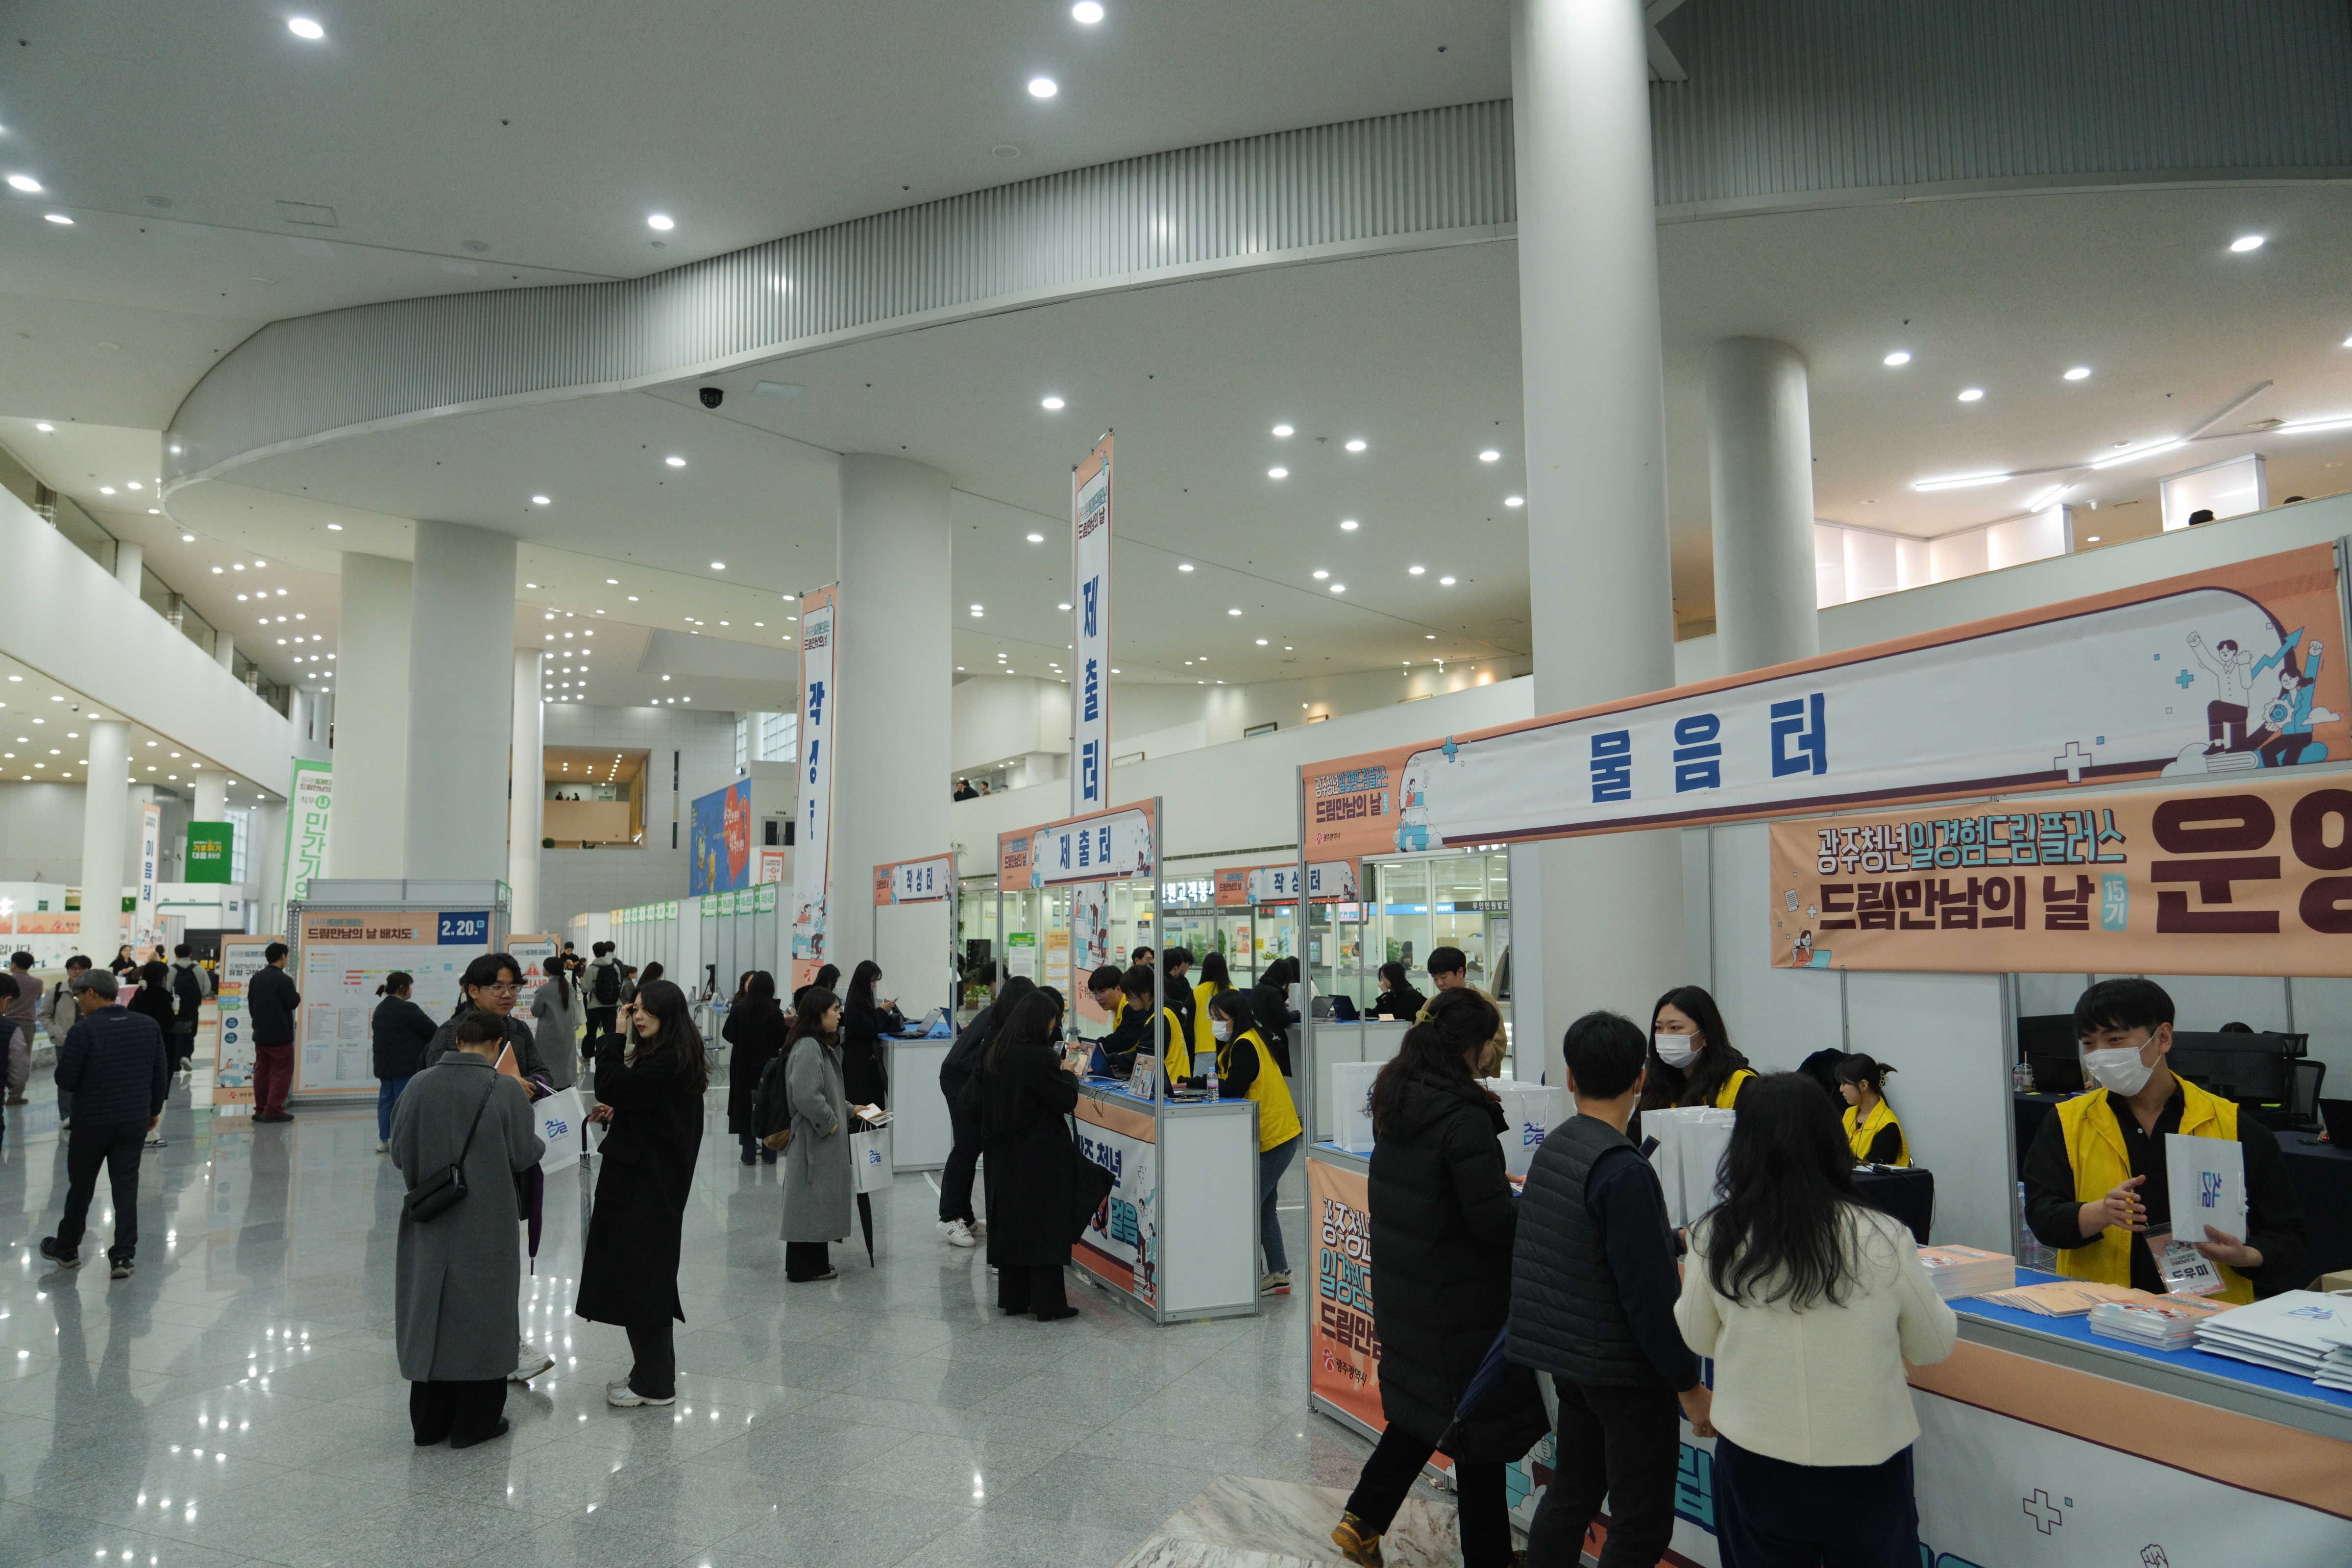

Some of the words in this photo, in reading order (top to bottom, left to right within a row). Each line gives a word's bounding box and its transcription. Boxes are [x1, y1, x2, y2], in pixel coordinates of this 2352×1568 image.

[1082, 574, 1100, 802] 제출터
[1316, 794, 1367, 823] 드림만남의
[1370, 792, 1382, 816] 날
[1059, 825, 1111, 870] 제출터
[1817, 808, 2127, 875] 광주청년일경험드림플러스
[906, 866, 932, 893] 작성터
[1162, 880, 1215, 904] 원고객봉
[2105, 881, 2125, 902] 15
[1818, 875, 2027, 931] 드림만남의
[2042, 874, 2095, 931] 날
[2105, 903, 2125, 924] 기
[307, 929, 363, 939] 드림만남의
[366, 928, 378, 939] 날
[380, 928, 412, 939] 배치도
[1320, 1248, 1375, 1316] 일경험드
[2171, 1263, 2209, 1281] 도우미
[1335, 1357, 1368, 1387] 광주광역시
